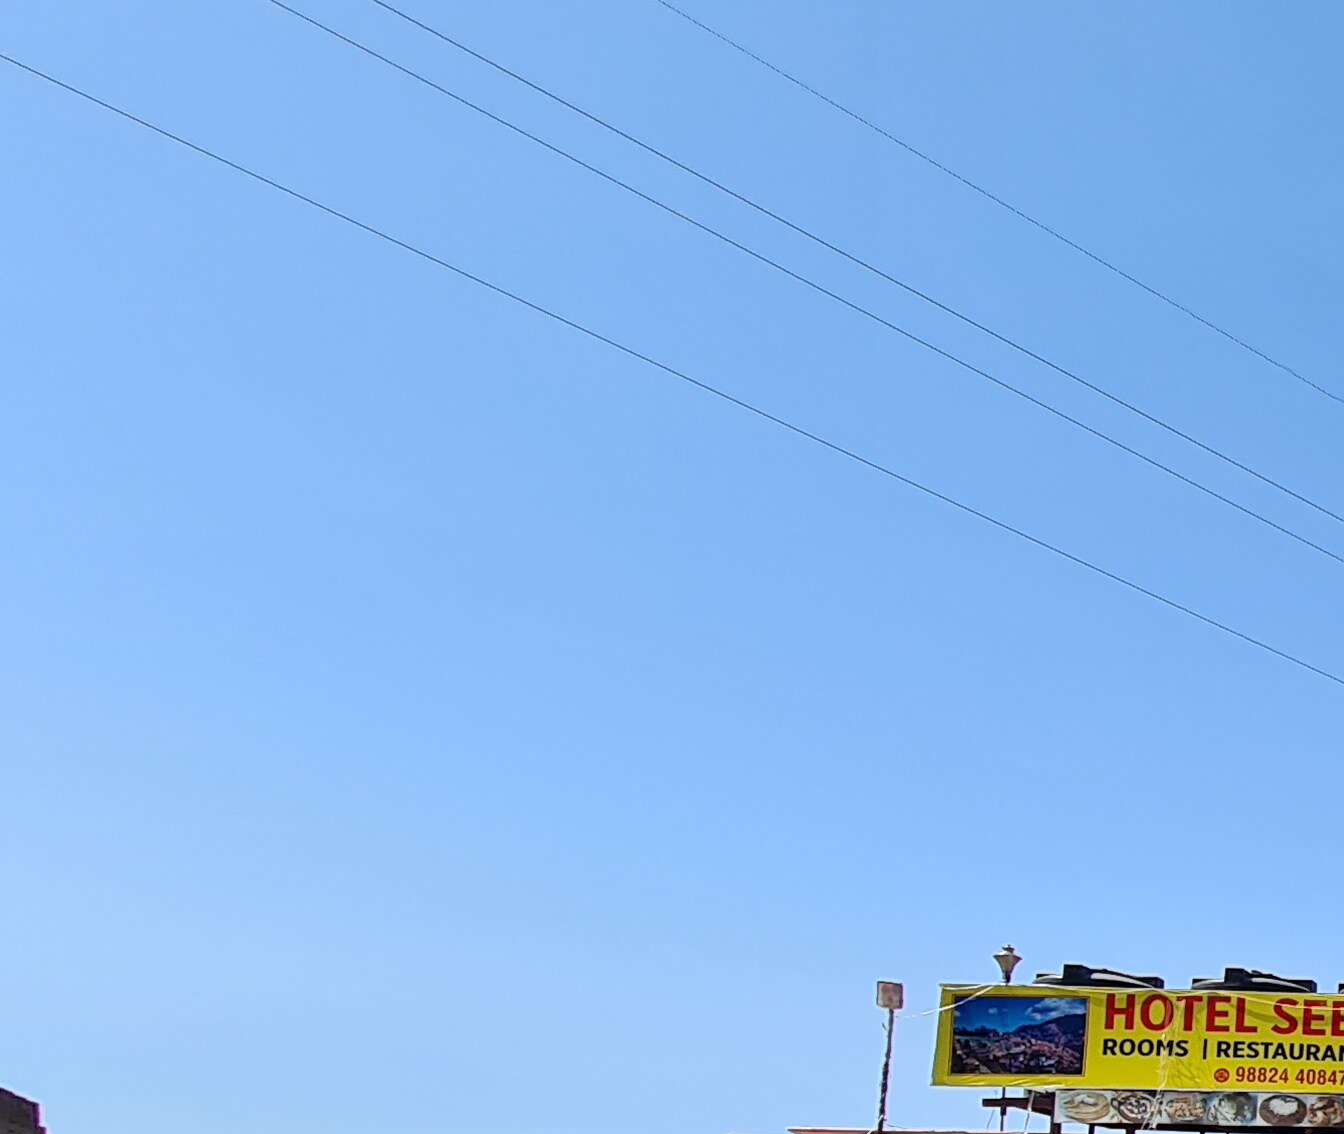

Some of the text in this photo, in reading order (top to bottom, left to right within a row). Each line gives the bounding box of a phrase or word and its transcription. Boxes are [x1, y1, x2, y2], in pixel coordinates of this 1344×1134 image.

[1104, 993, 1257, 1033] HOTEL
[1102, 1038, 1189, 1057] ROOMS
[1235, 1067, 1289, 1084] 98824
